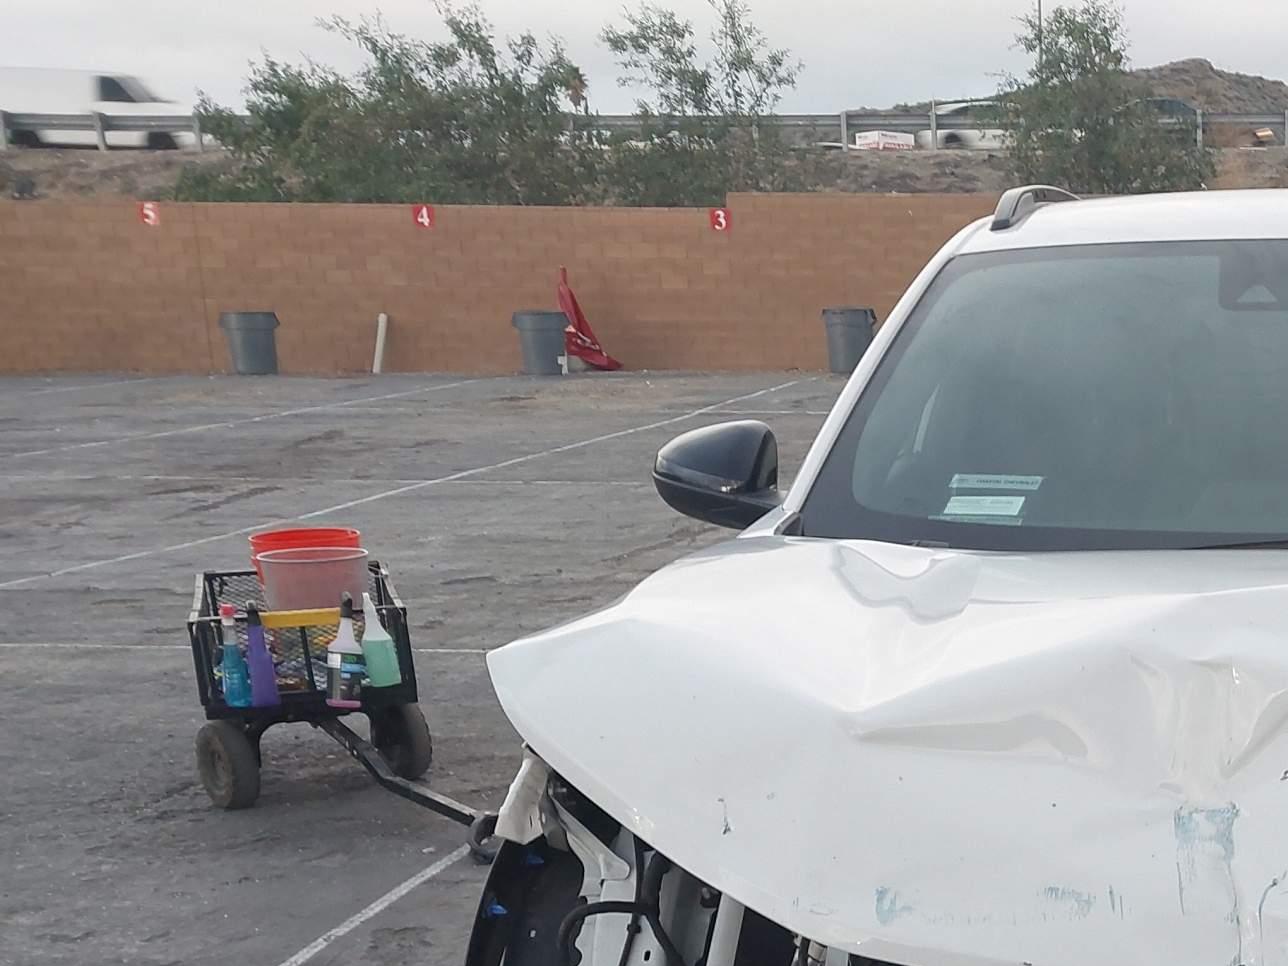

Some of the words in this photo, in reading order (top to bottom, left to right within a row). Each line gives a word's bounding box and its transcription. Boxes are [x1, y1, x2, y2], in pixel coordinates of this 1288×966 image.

[143, 202, 155, 225] 5
[417, 205, 430, 226] 4
[714, 209, 727, 230] 3
